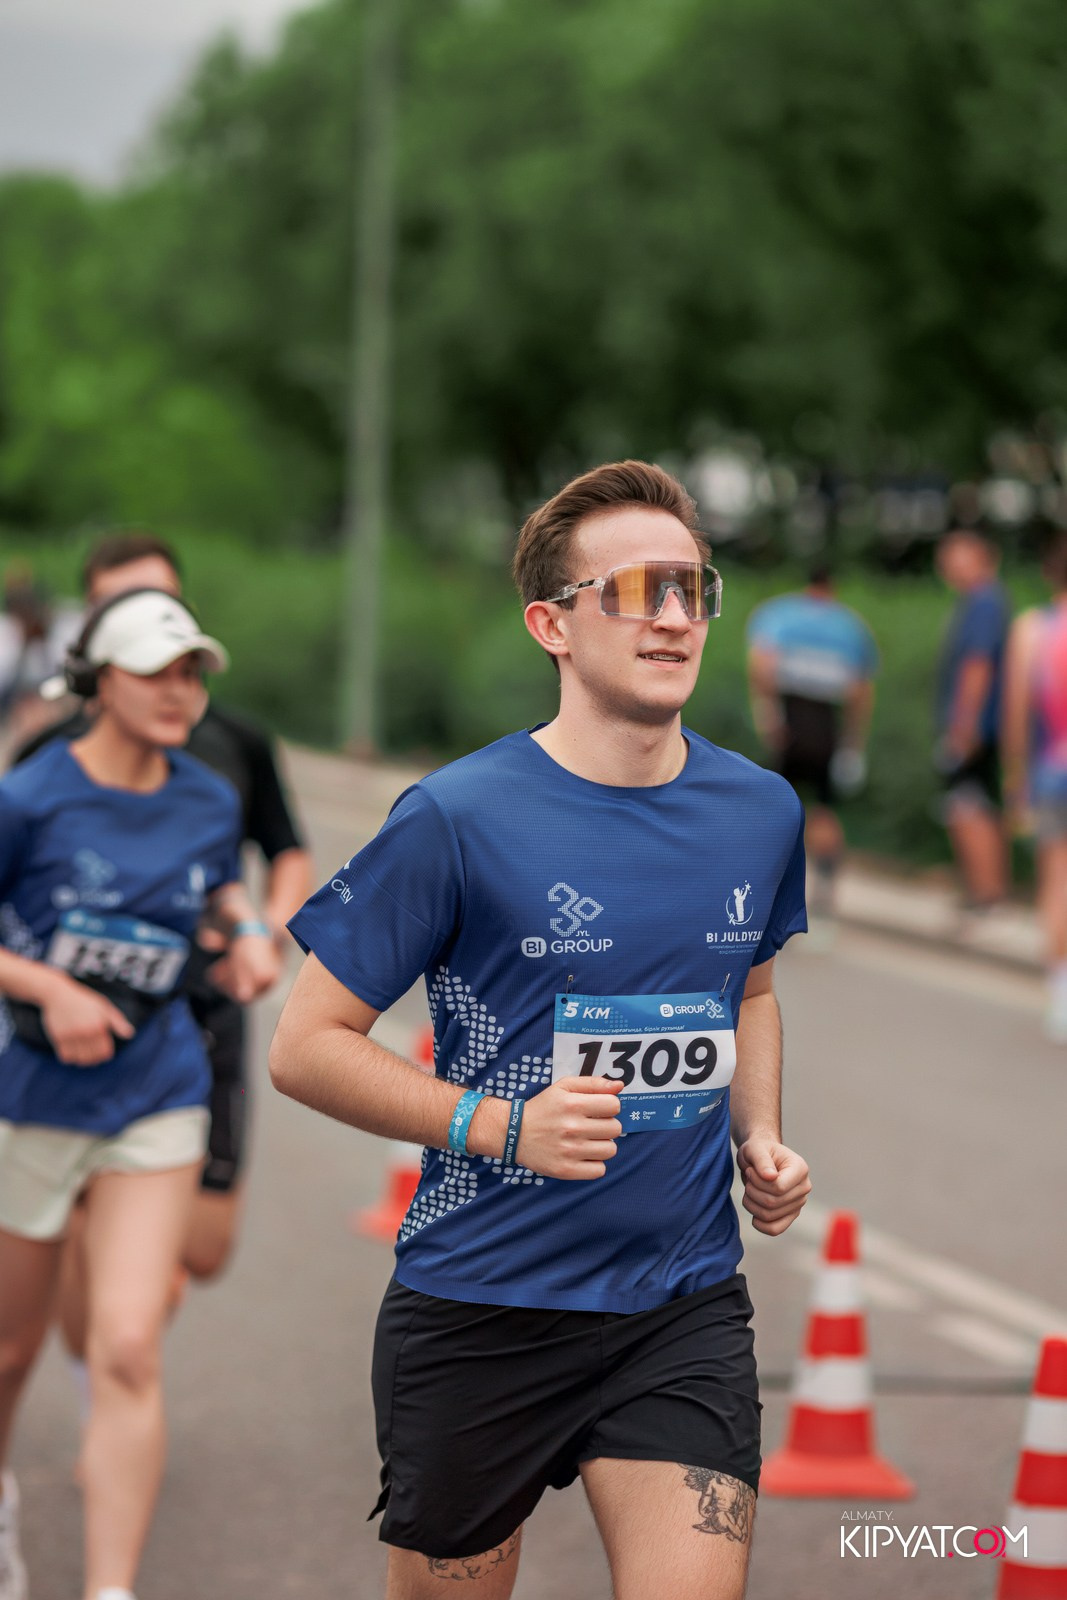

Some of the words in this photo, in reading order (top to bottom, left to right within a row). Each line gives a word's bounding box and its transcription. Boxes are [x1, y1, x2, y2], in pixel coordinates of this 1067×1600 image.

[331, 879, 354, 905] City
[706, 932, 718, 943] BI
[550, 938, 614, 954] GROUP
[563, 1001, 580, 1018] 5
[582, 1006, 611, 1020] KM
[674, 1004, 706, 1015] GROUP
[578, 1036, 718, 1088] 1309
[510, 1113, 519, 1126] City
